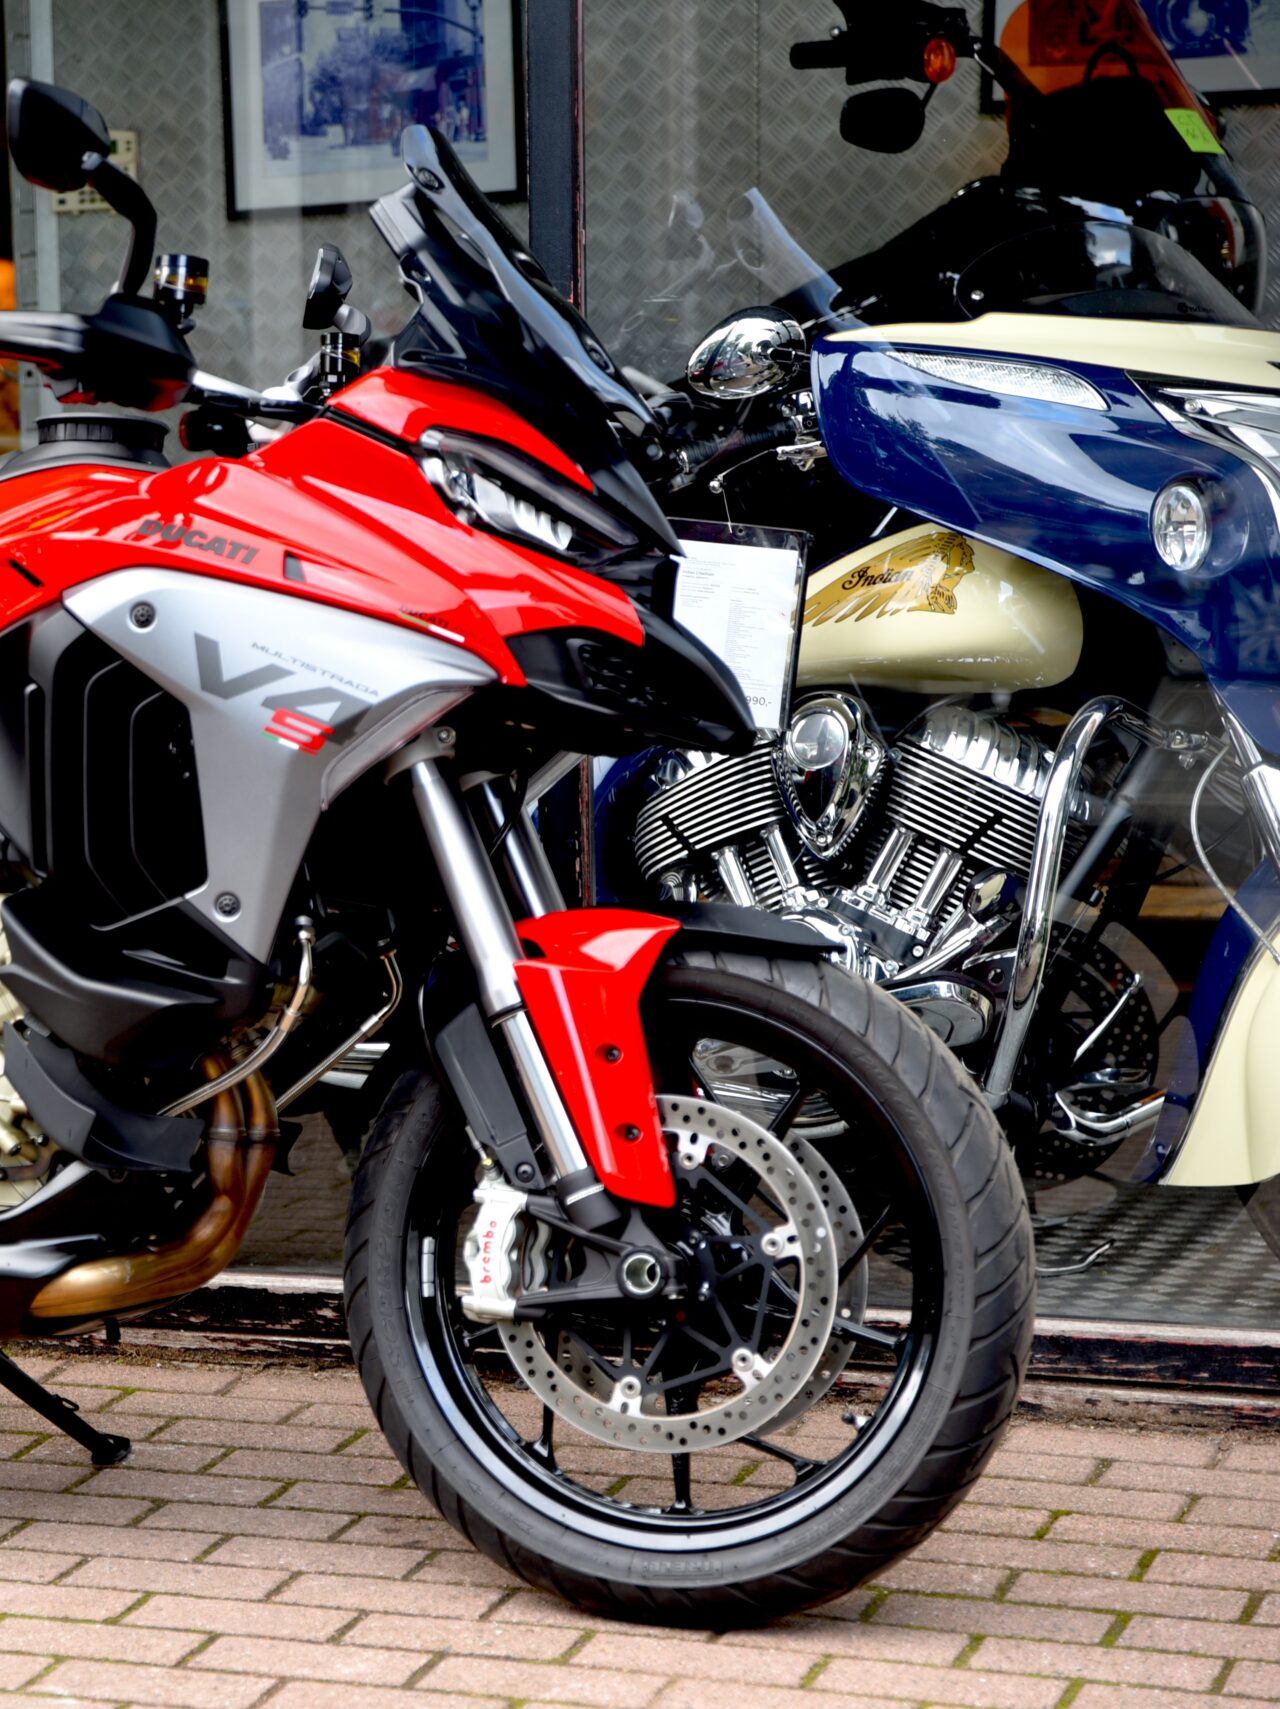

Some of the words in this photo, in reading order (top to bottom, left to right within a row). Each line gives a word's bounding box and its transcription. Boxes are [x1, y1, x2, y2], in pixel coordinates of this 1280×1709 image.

[137, 519, 259, 564] DUCATI
[841, 566, 915, 590] Indian
[251, 642, 380, 697] MULTISTRADA
[480, 1220, 498, 1284] brembo
